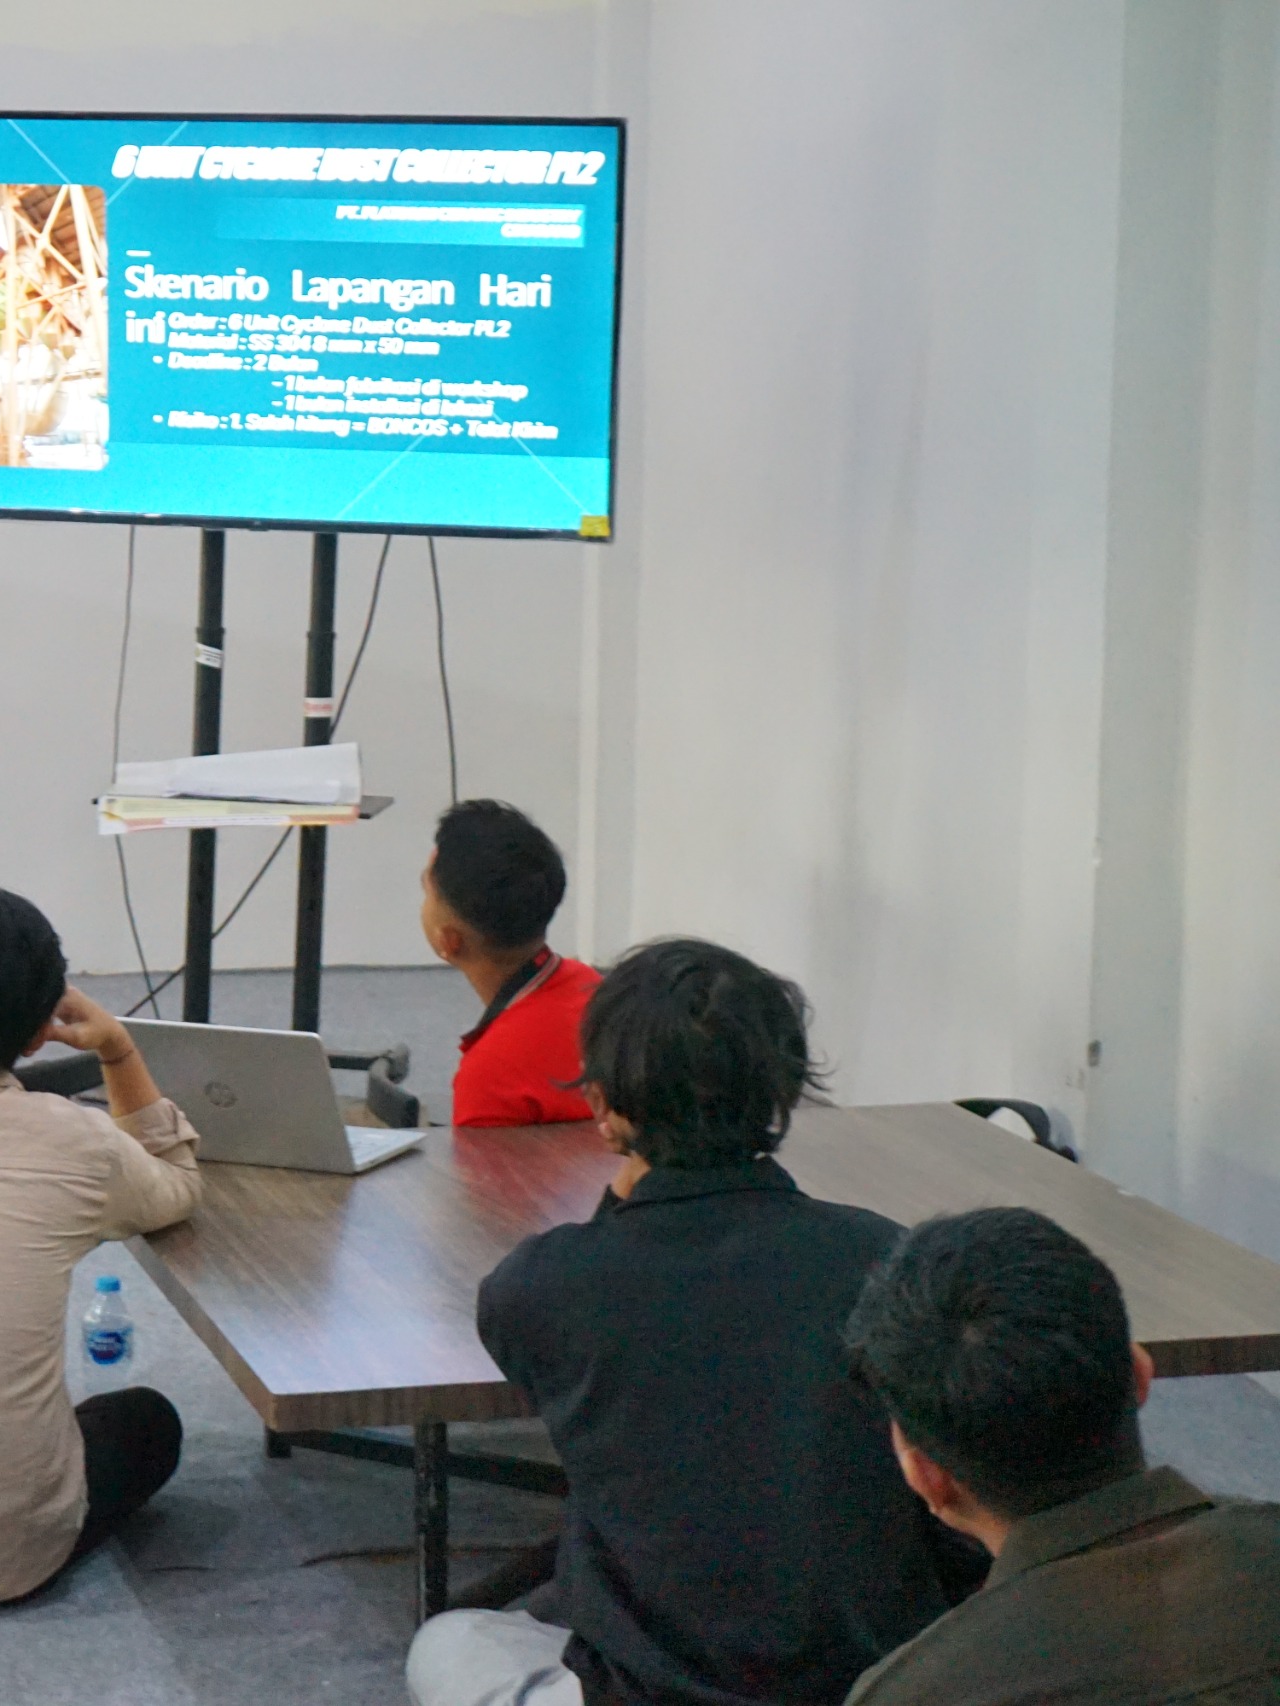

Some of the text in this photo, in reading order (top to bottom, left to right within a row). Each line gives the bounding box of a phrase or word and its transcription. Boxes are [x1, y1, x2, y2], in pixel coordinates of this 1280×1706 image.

[112, 145, 140, 178] 6
[125, 264, 551, 312] Skenario Lapangan Hari
[228, 313, 243, 331] 6
[247, 334, 274, 351] SS
[274, 334, 312, 352] 304
[377, 337, 405, 355] 50
[252, 354, 268, 371] 2
